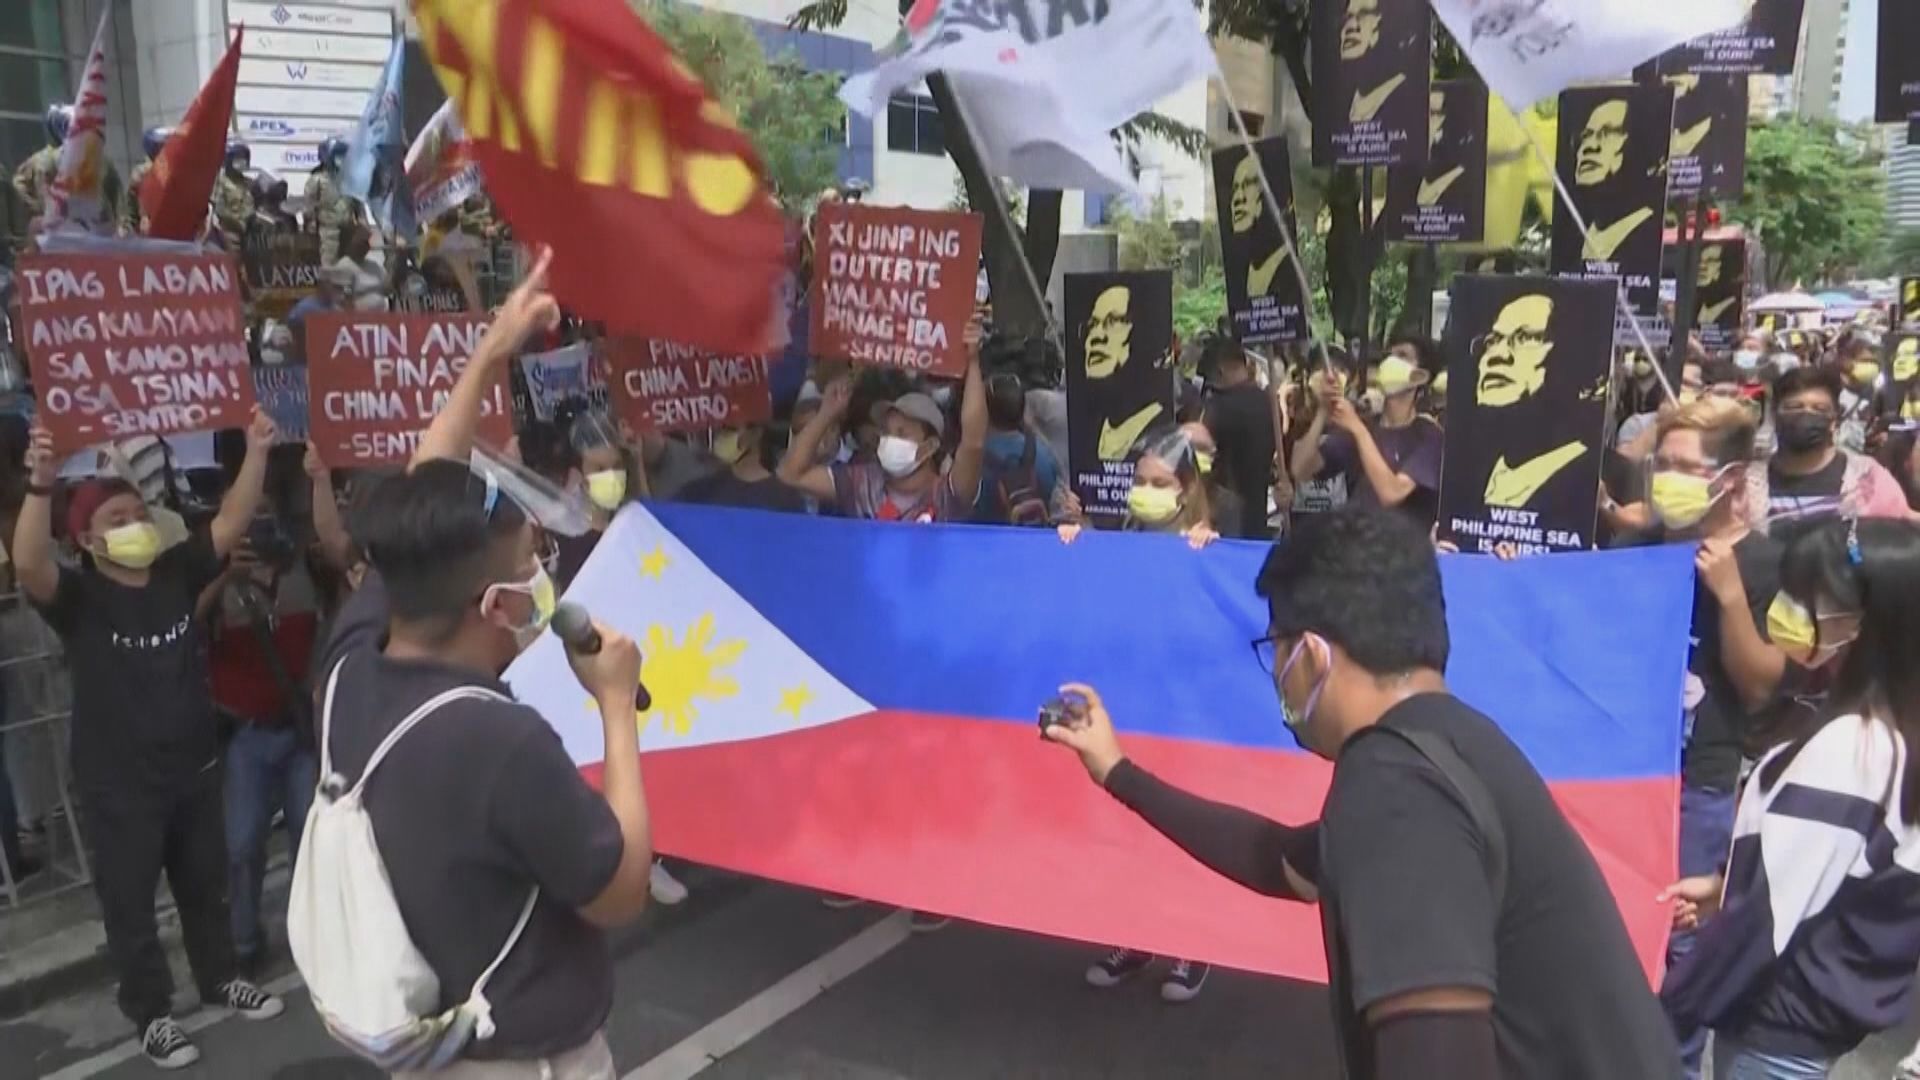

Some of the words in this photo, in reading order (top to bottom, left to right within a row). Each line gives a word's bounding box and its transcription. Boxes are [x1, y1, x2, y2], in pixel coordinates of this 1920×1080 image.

[1752, 37, 1776, 48] SEA
[1703, 50, 1714, 60] IS
[249, 120, 288, 131] APEX
[1353, 121, 1382, 132] WEST
[1331, 132, 1385, 145] PHILIPPINE
[1388, 129, 1408, 142] SEA
[828, 221, 854, 247] XI
[23, 268, 105, 304] IPAG
[119, 264, 230, 297] LABAN
[1625, 275, 1651, 287] SEA
[822, 279, 927, 318] WALANG
[32, 315, 96, 346] ANG
[330, 322, 408, 359] ATIN
[48, 351, 93, 380] SA
[624, 365, 688, 398] CHINA
[323, 390, 408, 421] CHINA
[1103, 461, 1135, 474] WEST
[1097, 487, 1109, 500] IS
[1490, 507, 1539, 526] WEST
[1451, 518, 1543, 542] PHILIPPINE
[1547, 530, 1582, 547] SEA
